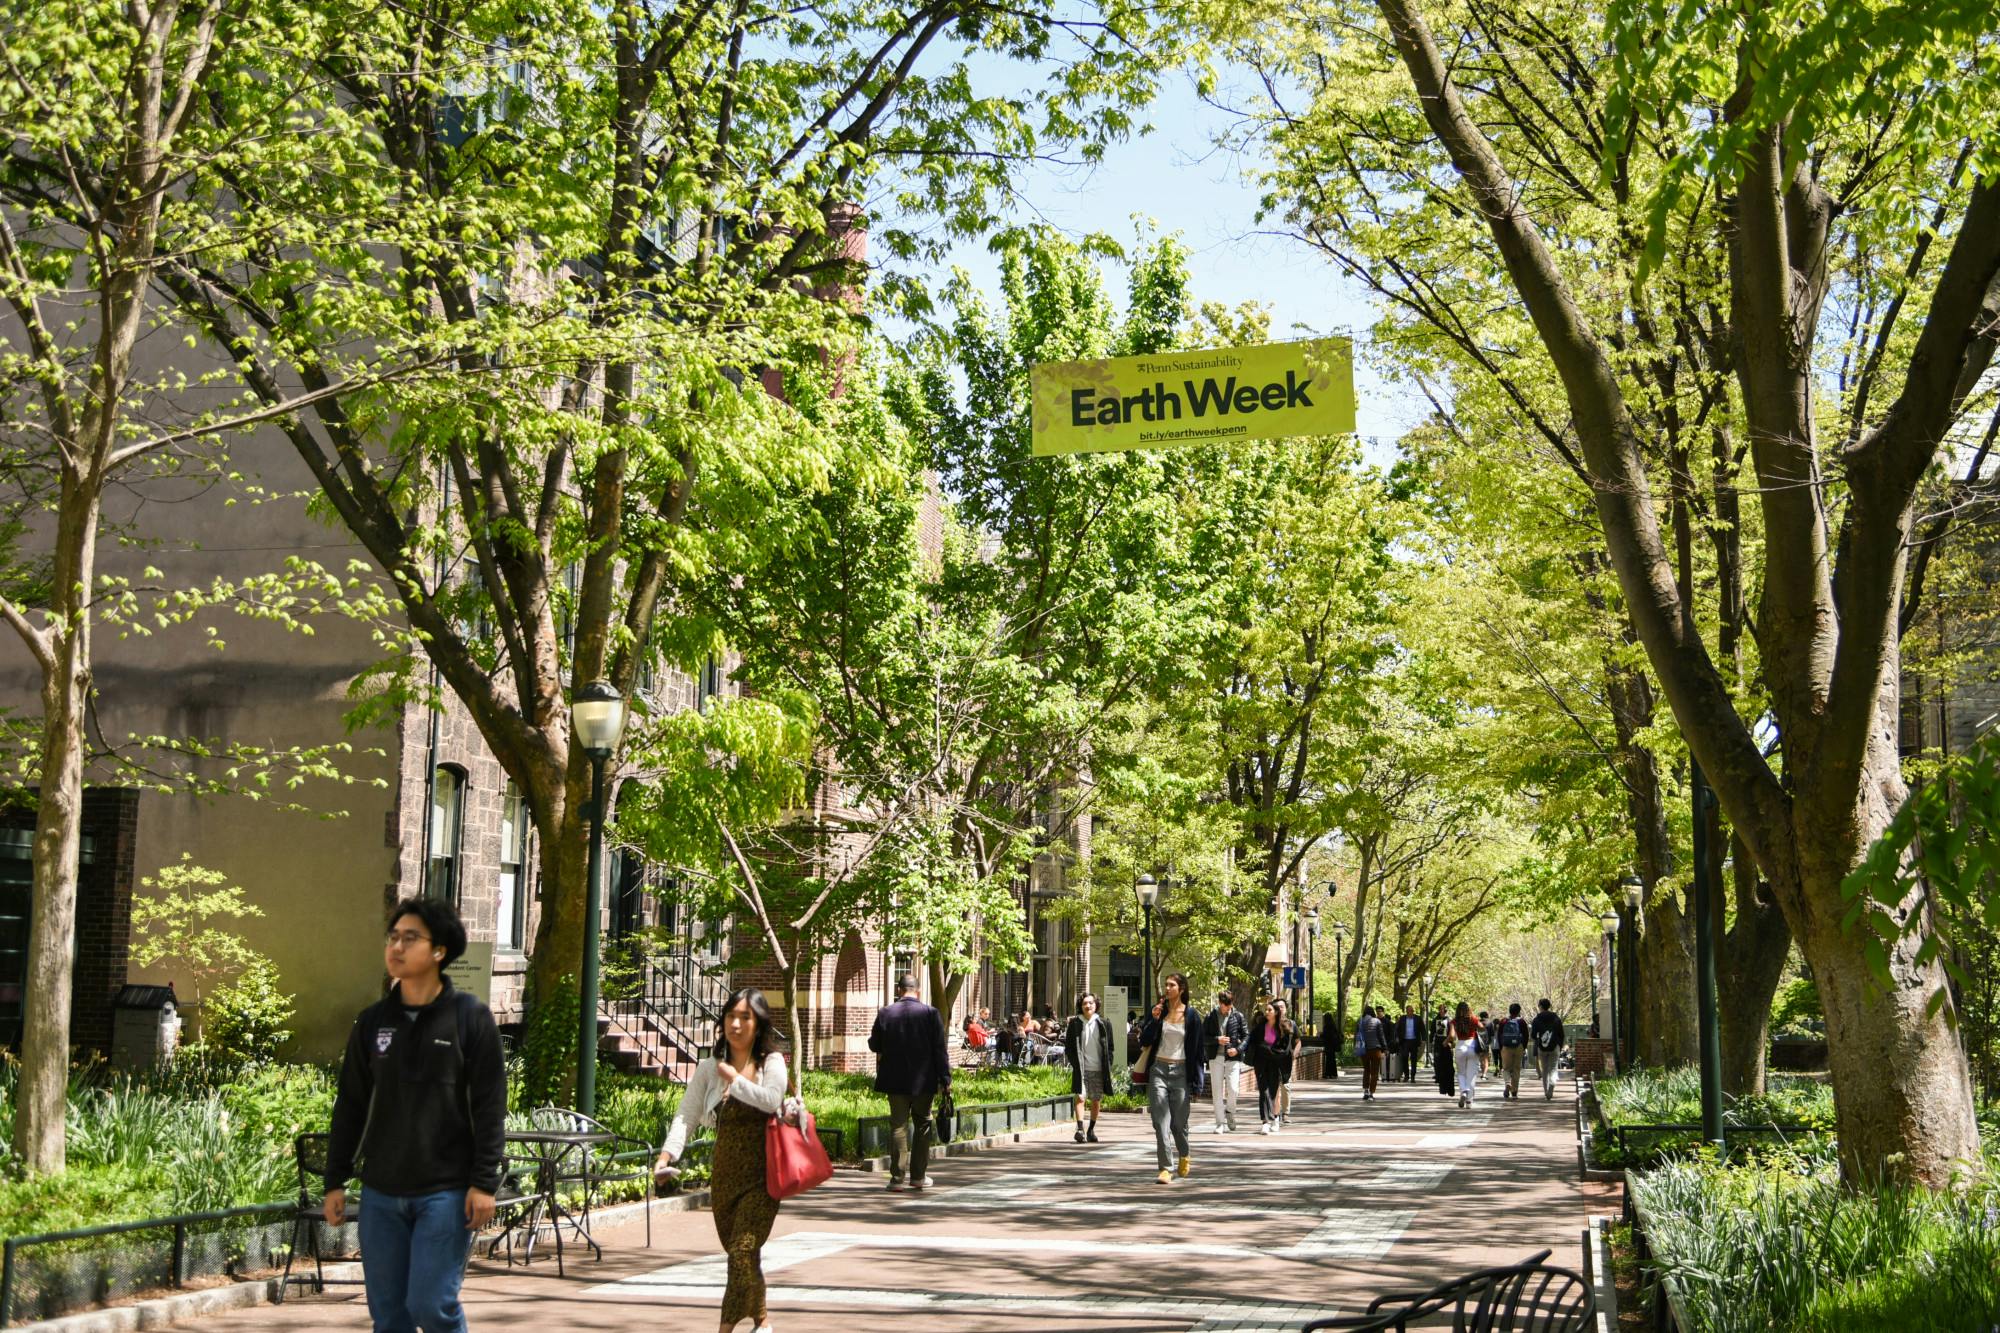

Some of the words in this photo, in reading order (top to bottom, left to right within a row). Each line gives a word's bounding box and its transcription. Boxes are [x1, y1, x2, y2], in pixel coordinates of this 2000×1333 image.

[1146, 362, 1172, 374] Penn
[1172, 355, 1243, 371] Sustainability
[1071, 382, 1182, 427] Earth
[1184, 370, 1314, 417] Week
[1139, 424, 1247, 441] bit.ly/earthweekpenn
